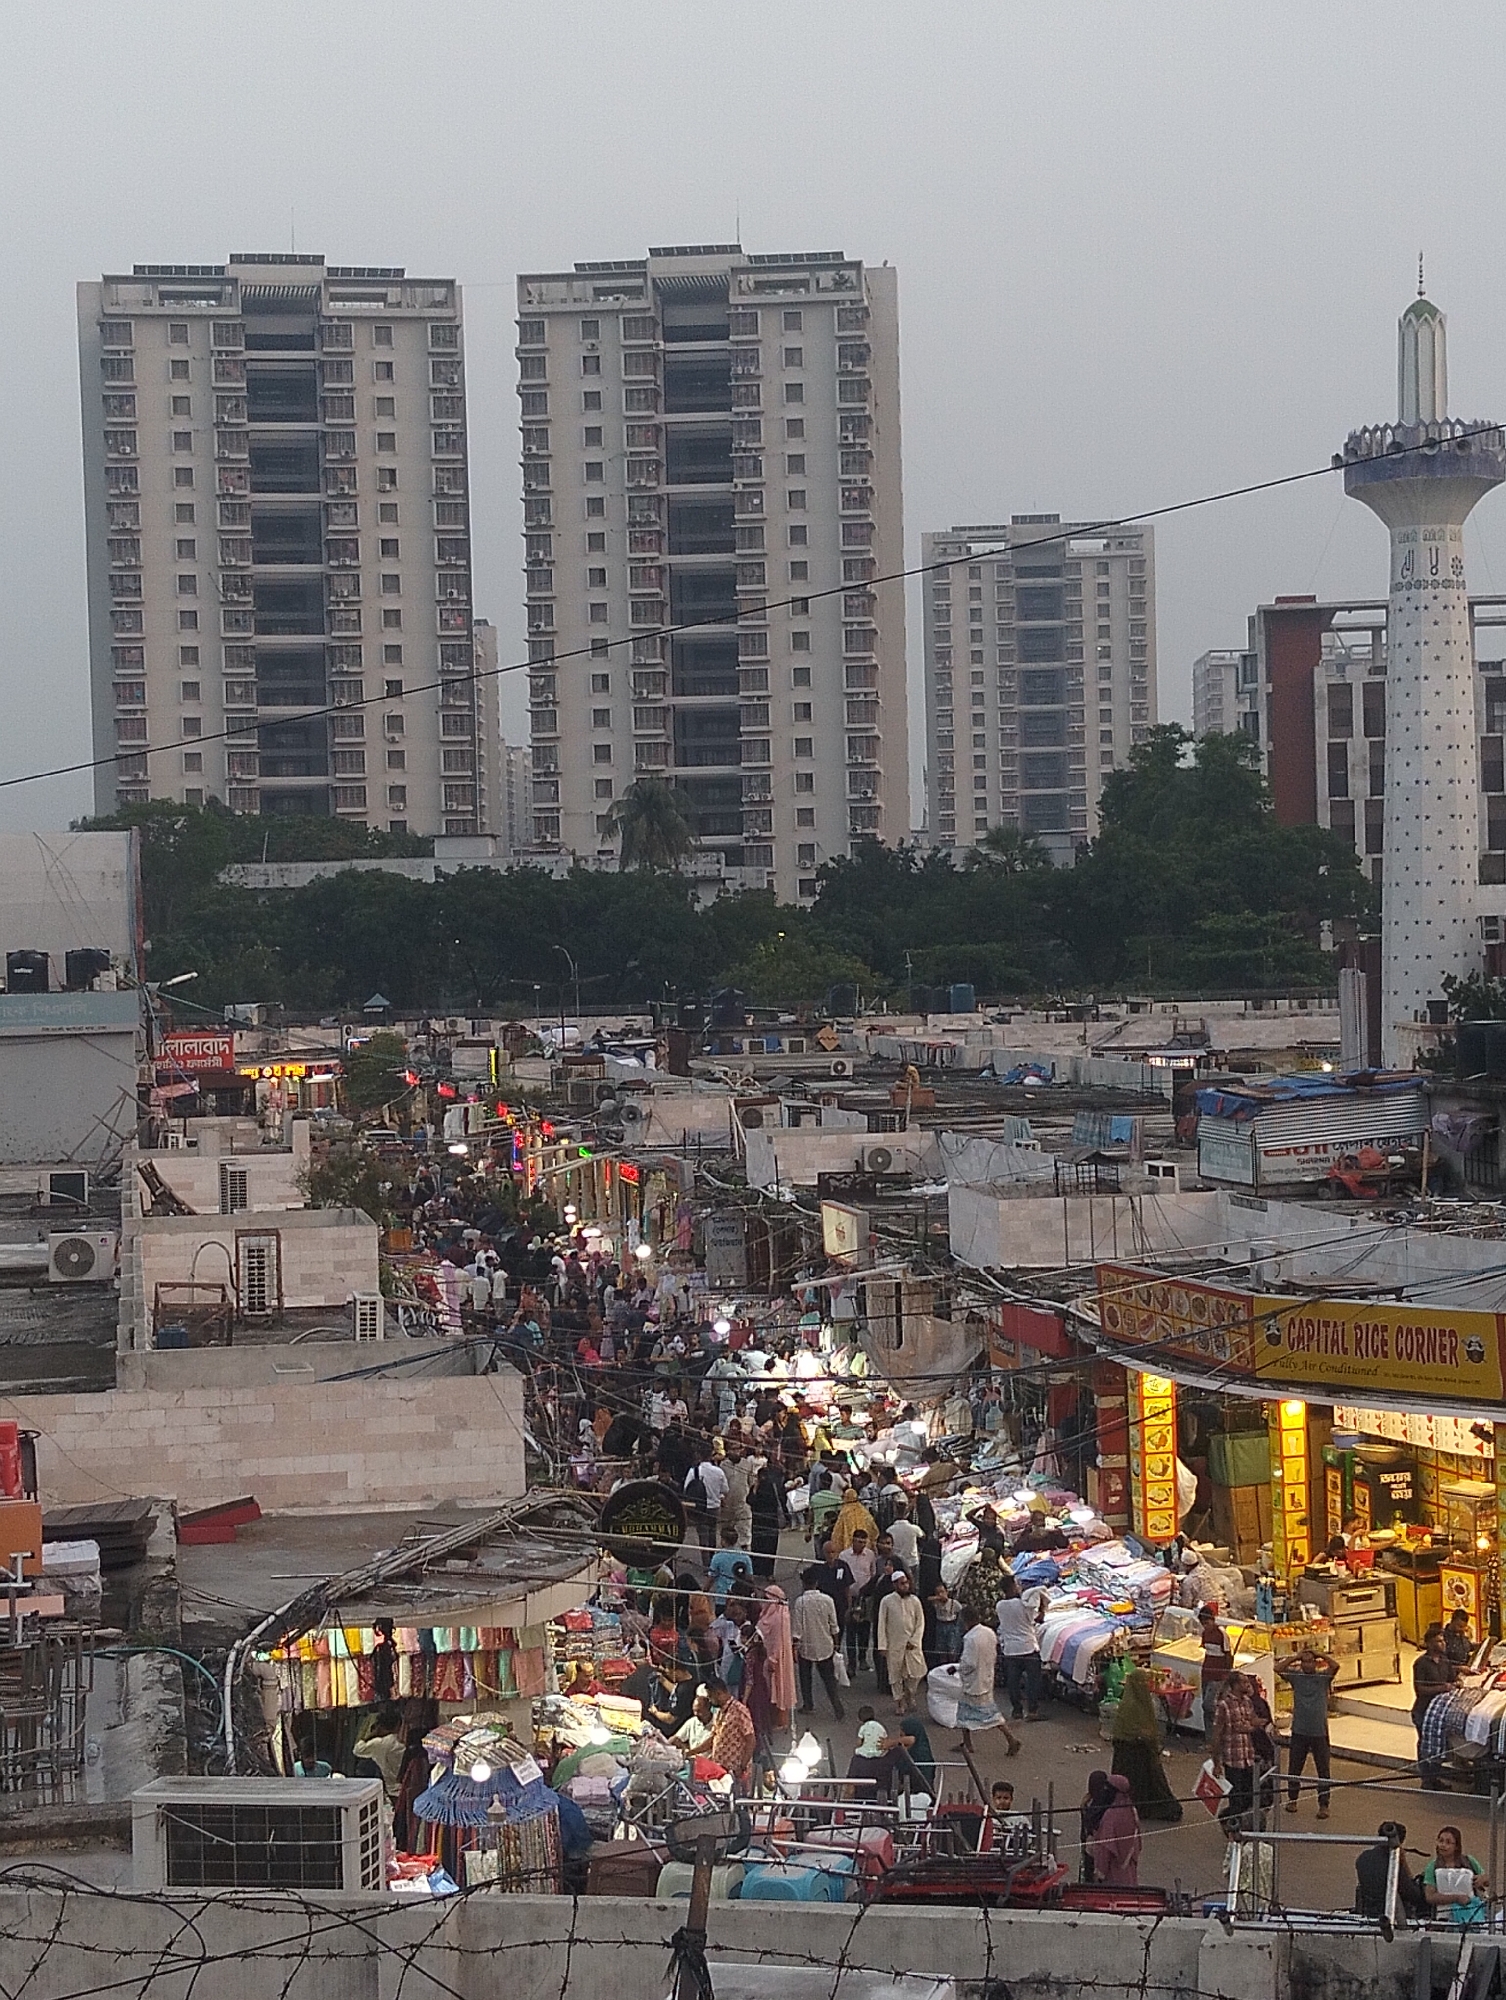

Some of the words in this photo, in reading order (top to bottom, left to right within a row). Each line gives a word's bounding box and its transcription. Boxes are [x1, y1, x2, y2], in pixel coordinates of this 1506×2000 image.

[1287, 1316, 1349, 1356] CAPITAL
[1354, 1321, 1389, 1360] RICE
[1395, 1325, 1460, 1368] CORNER
[1298, 1360, 1316, 1371] Air
